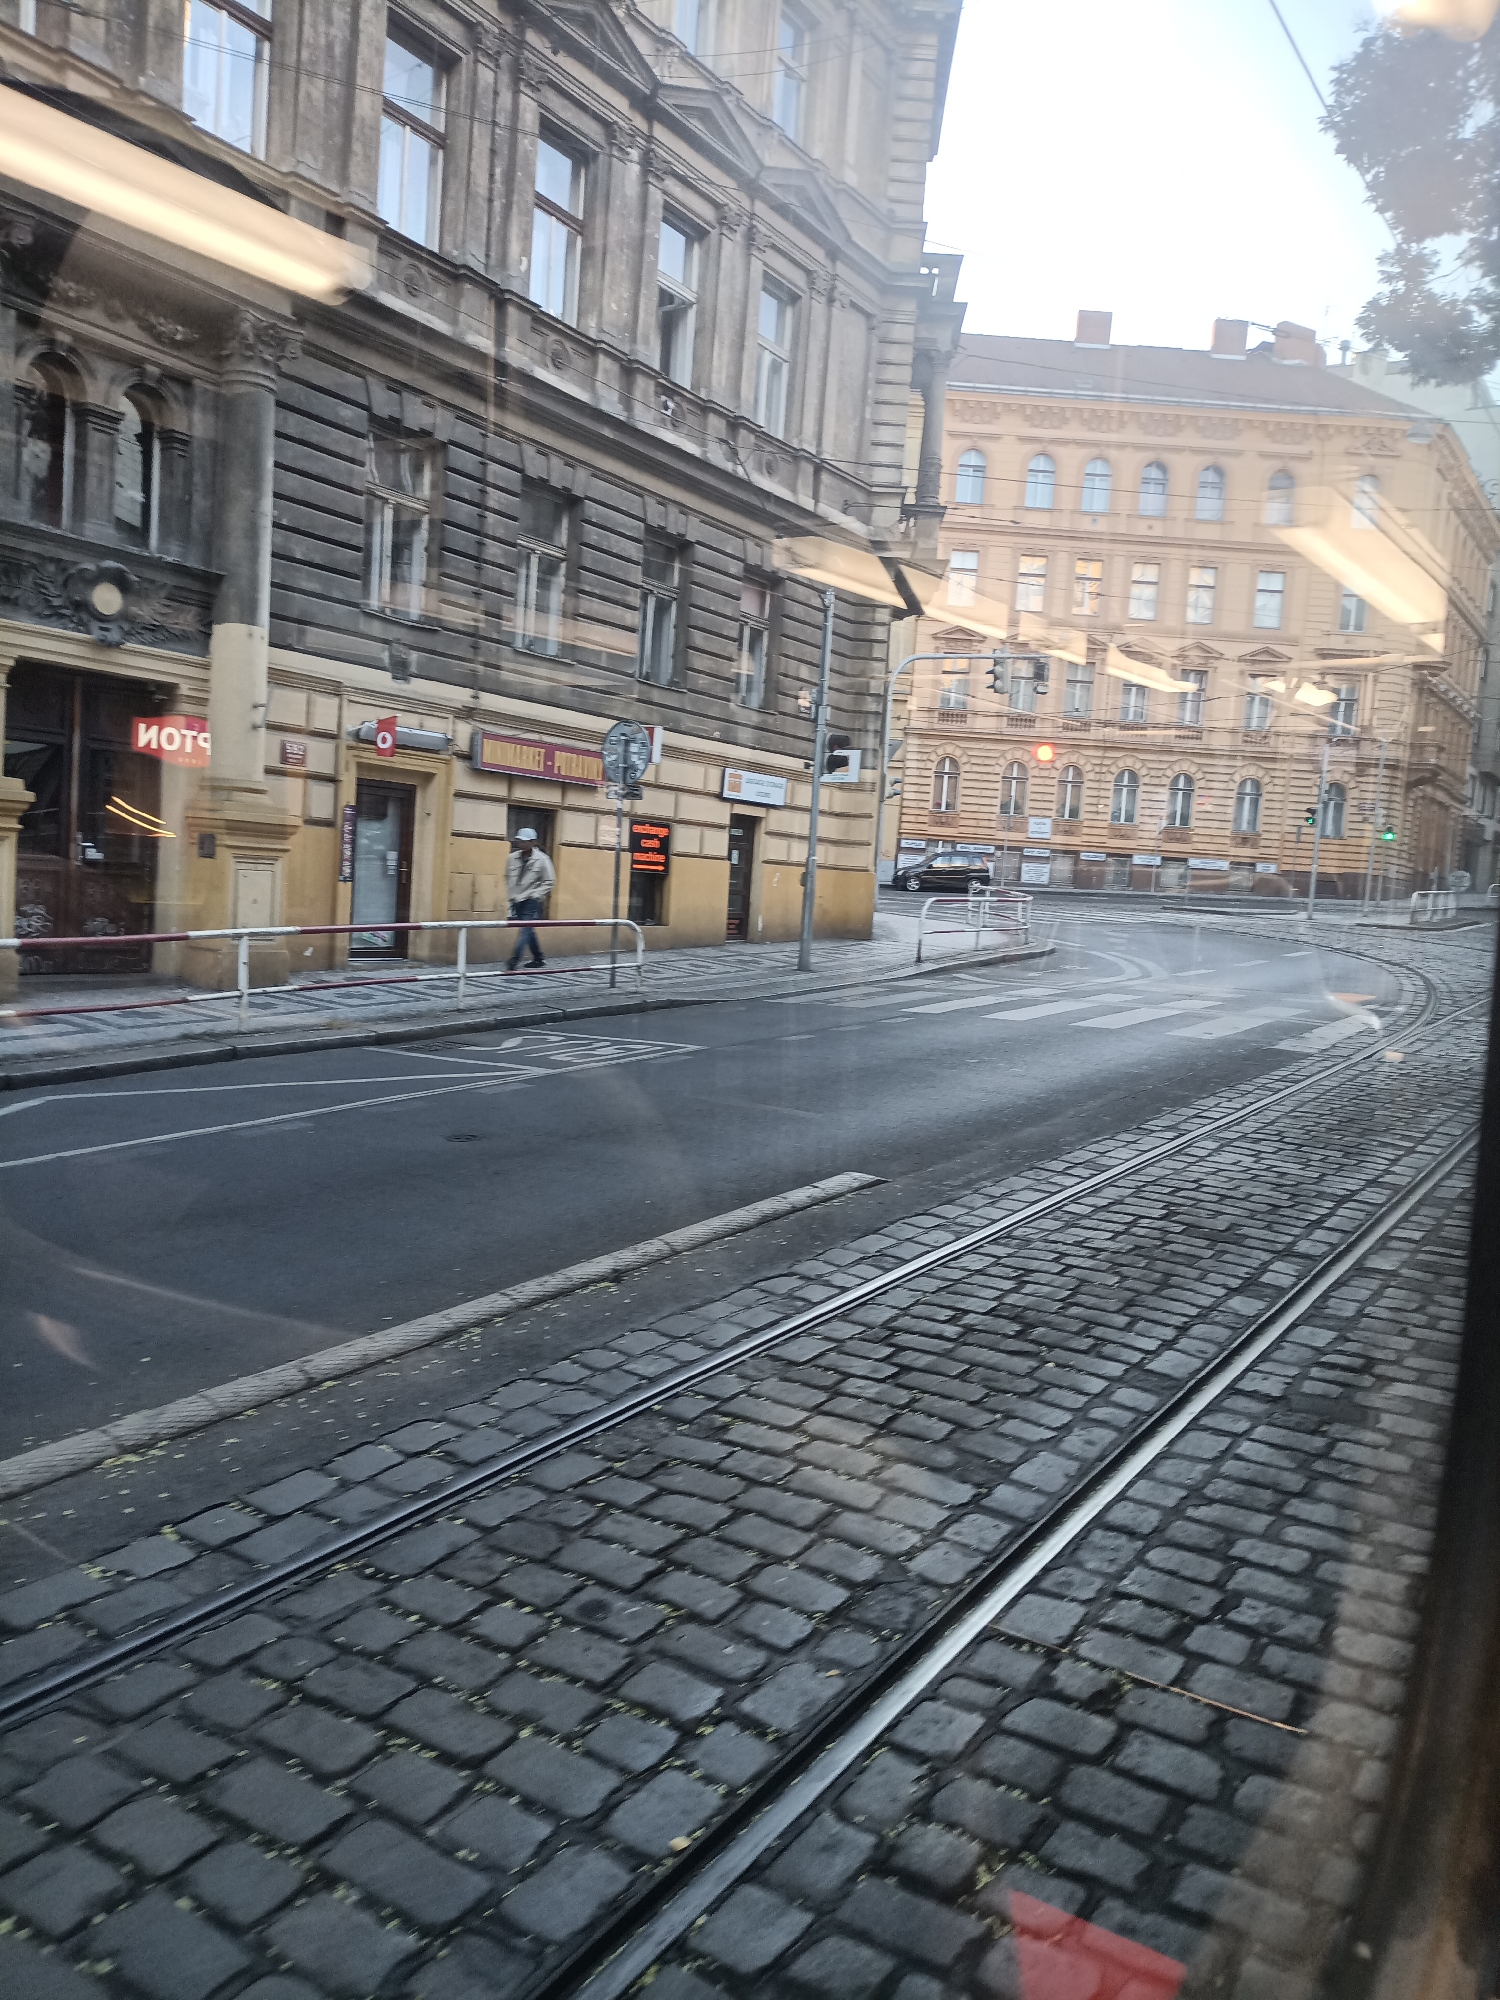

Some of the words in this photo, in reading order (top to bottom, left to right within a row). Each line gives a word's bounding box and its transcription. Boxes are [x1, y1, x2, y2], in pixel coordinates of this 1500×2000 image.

[632, 823, 670, 838] exchange
[640, 838, 661, 849] cash
[632, 851, 666, 863] machine
